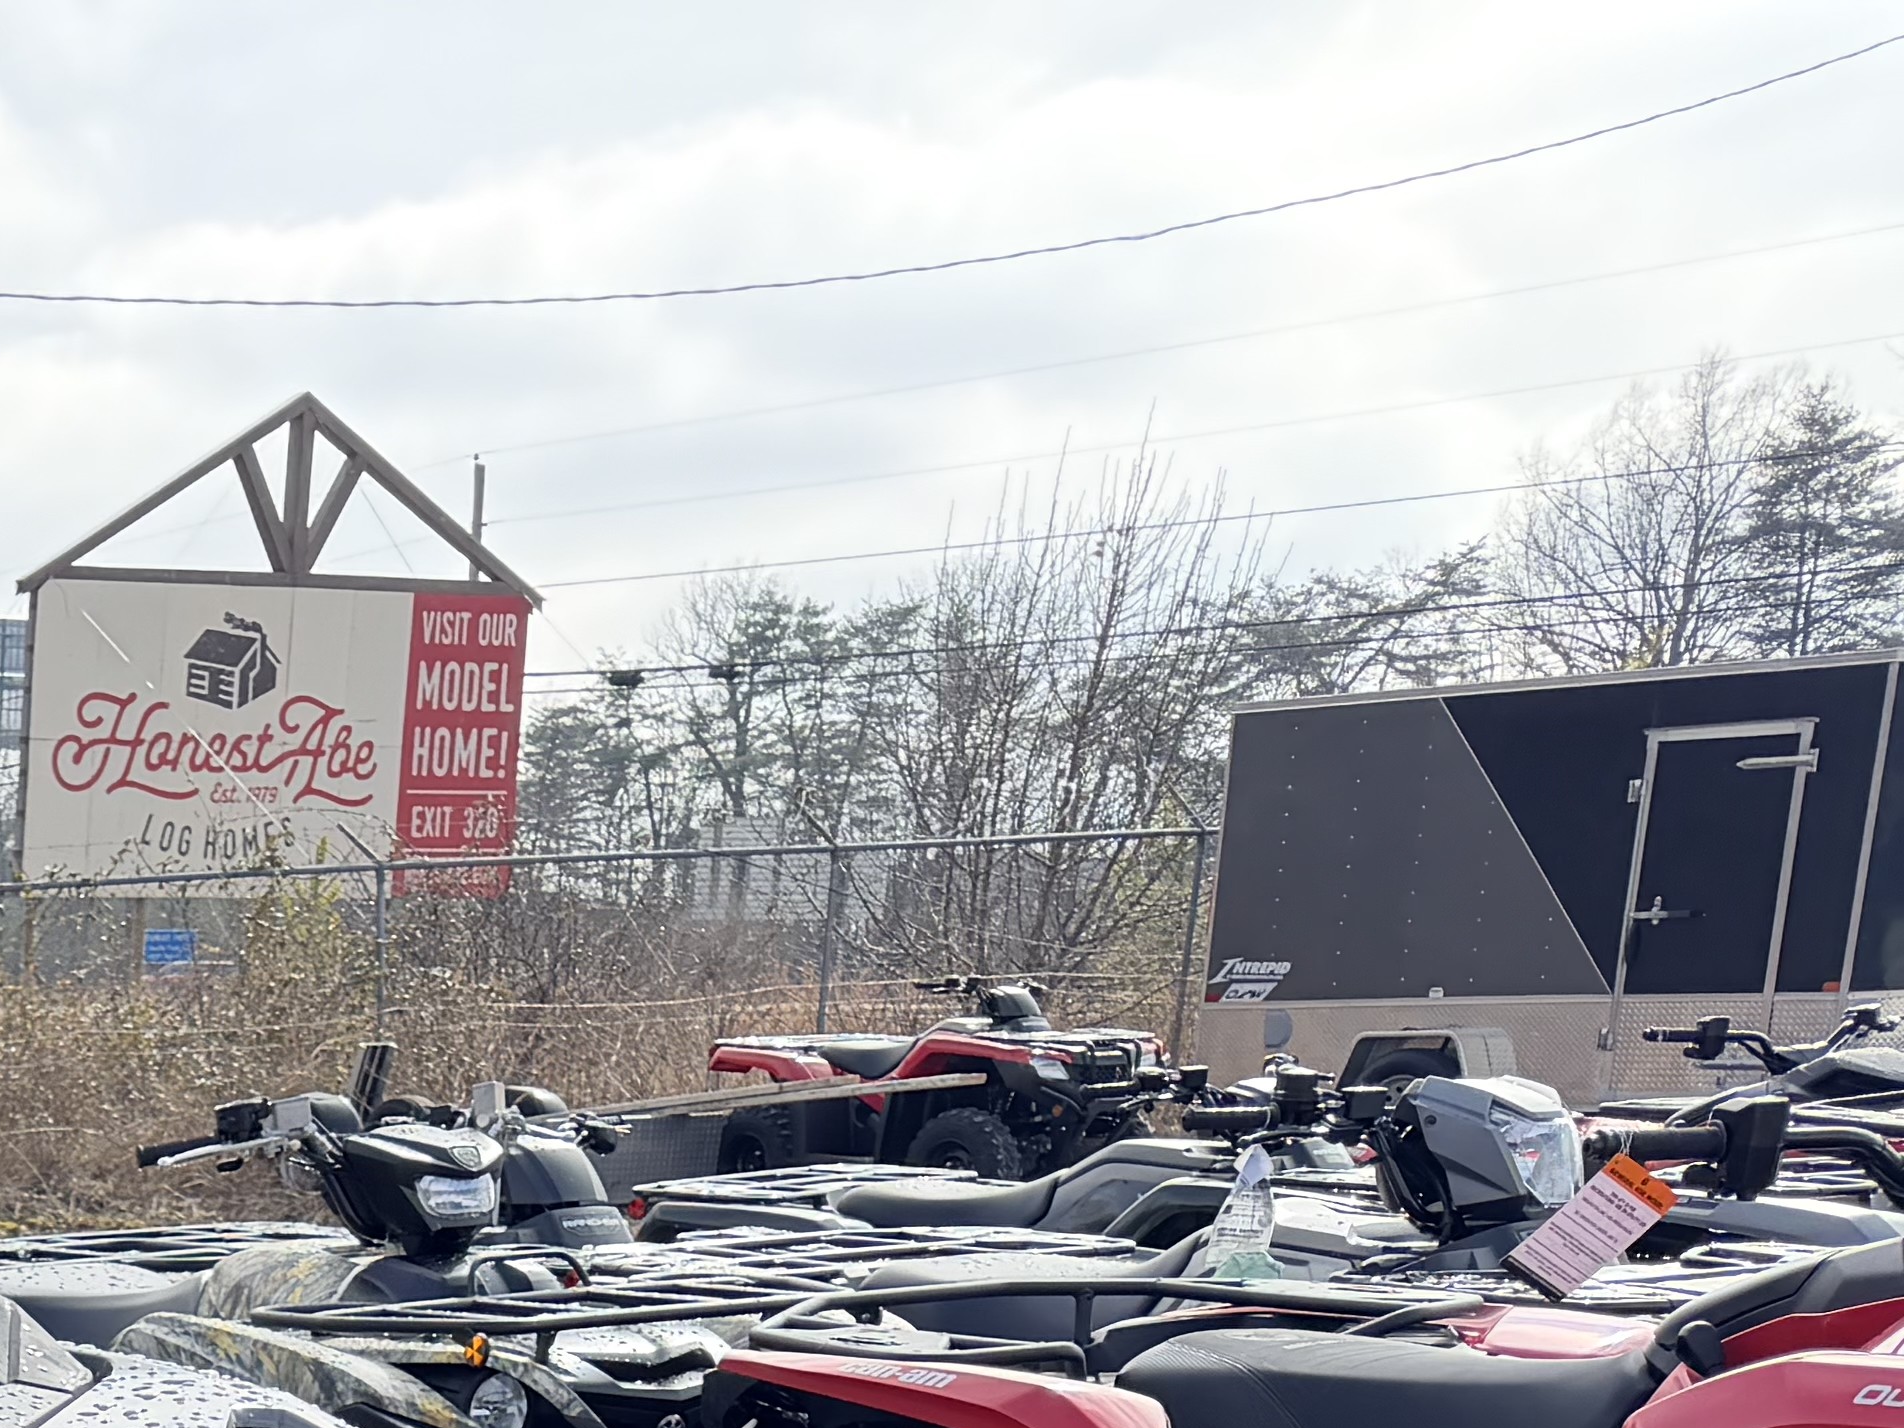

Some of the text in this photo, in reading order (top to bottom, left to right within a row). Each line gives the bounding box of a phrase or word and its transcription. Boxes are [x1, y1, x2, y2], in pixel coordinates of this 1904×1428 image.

[422, 610, 518, 648] VISIT OUR
[415, 660, 515, 713] MODEL
[52, 692, 378, 807] Honest Abe
[411, 726, 509, 779] HOME!
[209, 781, 242, 804] Est.
[141, 813, 295, 860] LOG HOMES
[410, 805, 453, 838] EXIT
[1208, 956, 1292, 985] INTREPID
[837, 1361, 958, 1389] can-am
